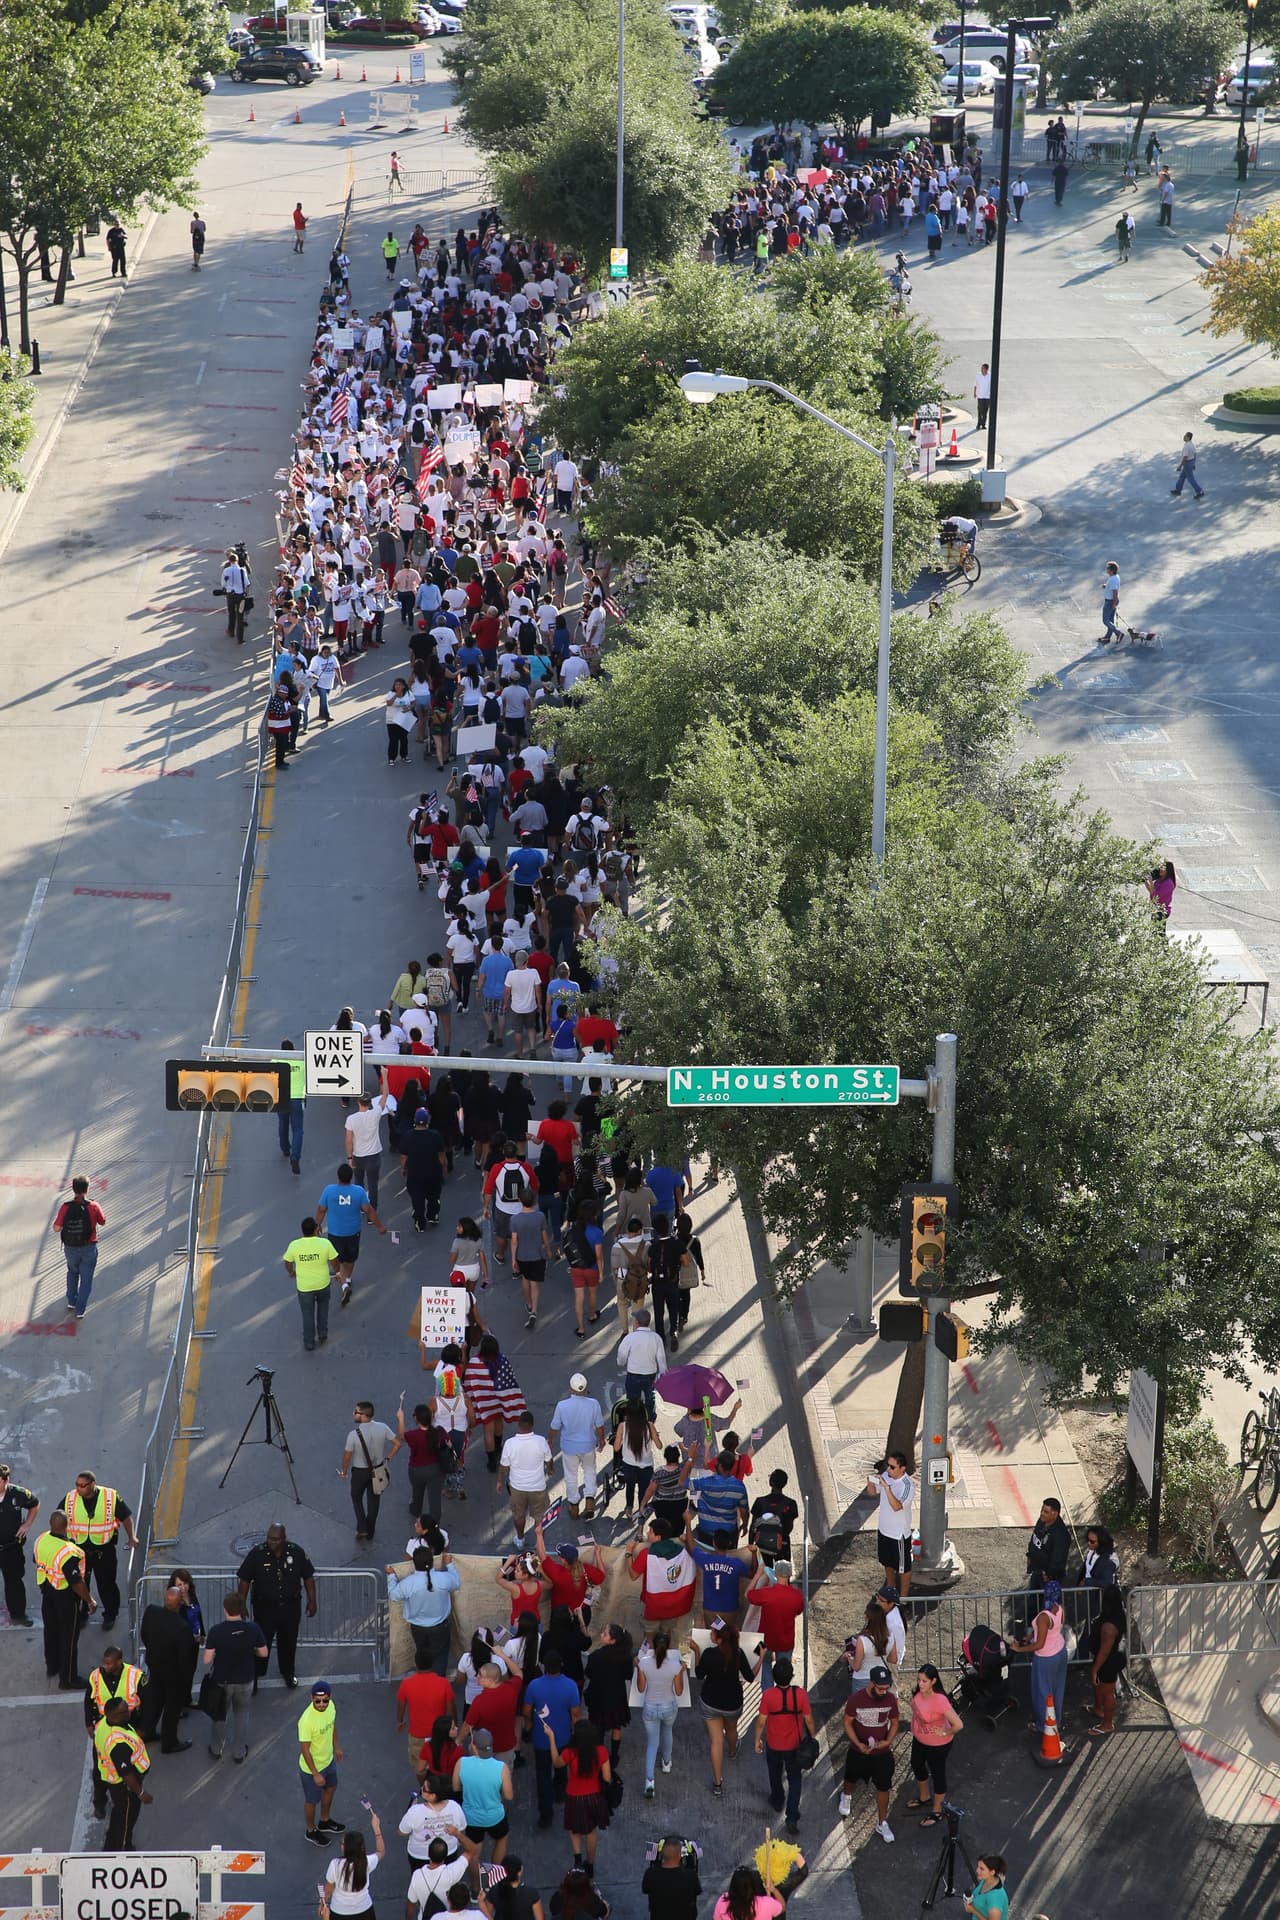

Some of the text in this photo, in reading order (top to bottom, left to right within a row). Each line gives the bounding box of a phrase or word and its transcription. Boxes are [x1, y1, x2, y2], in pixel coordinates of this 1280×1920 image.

[315, 1036, 353, 1051] ONE
[313, 1053, 354, 1069] WAY
[674, 1069, 893, 1090] N. Houston St.
[698, 1092, 870, 1101] 2600 2700
[299, 1254, 320, 1262] SECURITY
[434, 1289, 449, 1297] WE
[426, 1297, 456, 1306] WONT
[427, 1306, 457, 1315] HAVE
[424, 1325, 462, 1333] CLOWN
[435, 1336, 465, 1344] PREZ
[704, 1563, 734, 1574] ANDRUS
[714, 1574, 720, 1590] 1
[91, 1867, 168, 1890] ROAD
[77, 1898, 182, 1920] CLOSED
